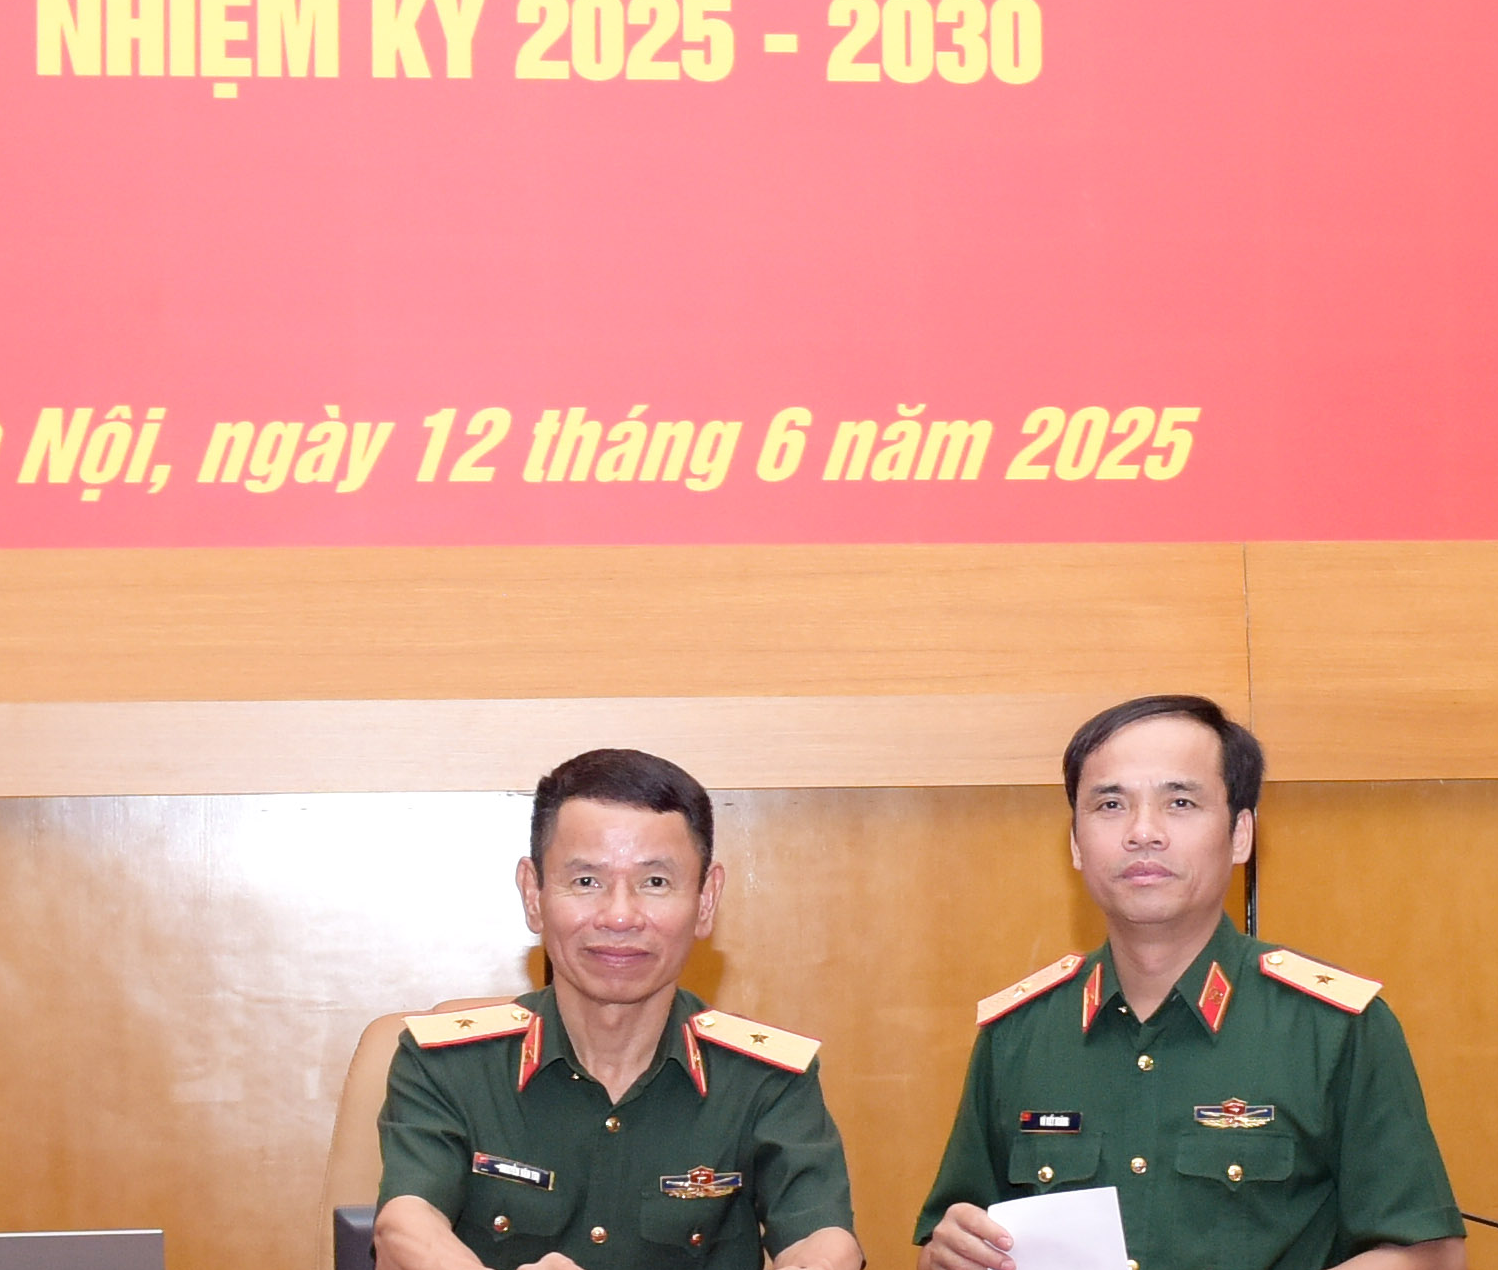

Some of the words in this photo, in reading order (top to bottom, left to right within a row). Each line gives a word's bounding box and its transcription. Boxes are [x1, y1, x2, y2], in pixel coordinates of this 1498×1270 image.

[764, 34, 798, 53] -
[17, 405, 171, 501] Nội,
[197, 405, 396, 493] ngày
[416, 407, 512, 482] 12
[522, 404, 743, 492] tháng
[756, 407, 812, 482] 6
[822, 404, 993, 481] năm
[1005, 406, 1201, 481] 2025
